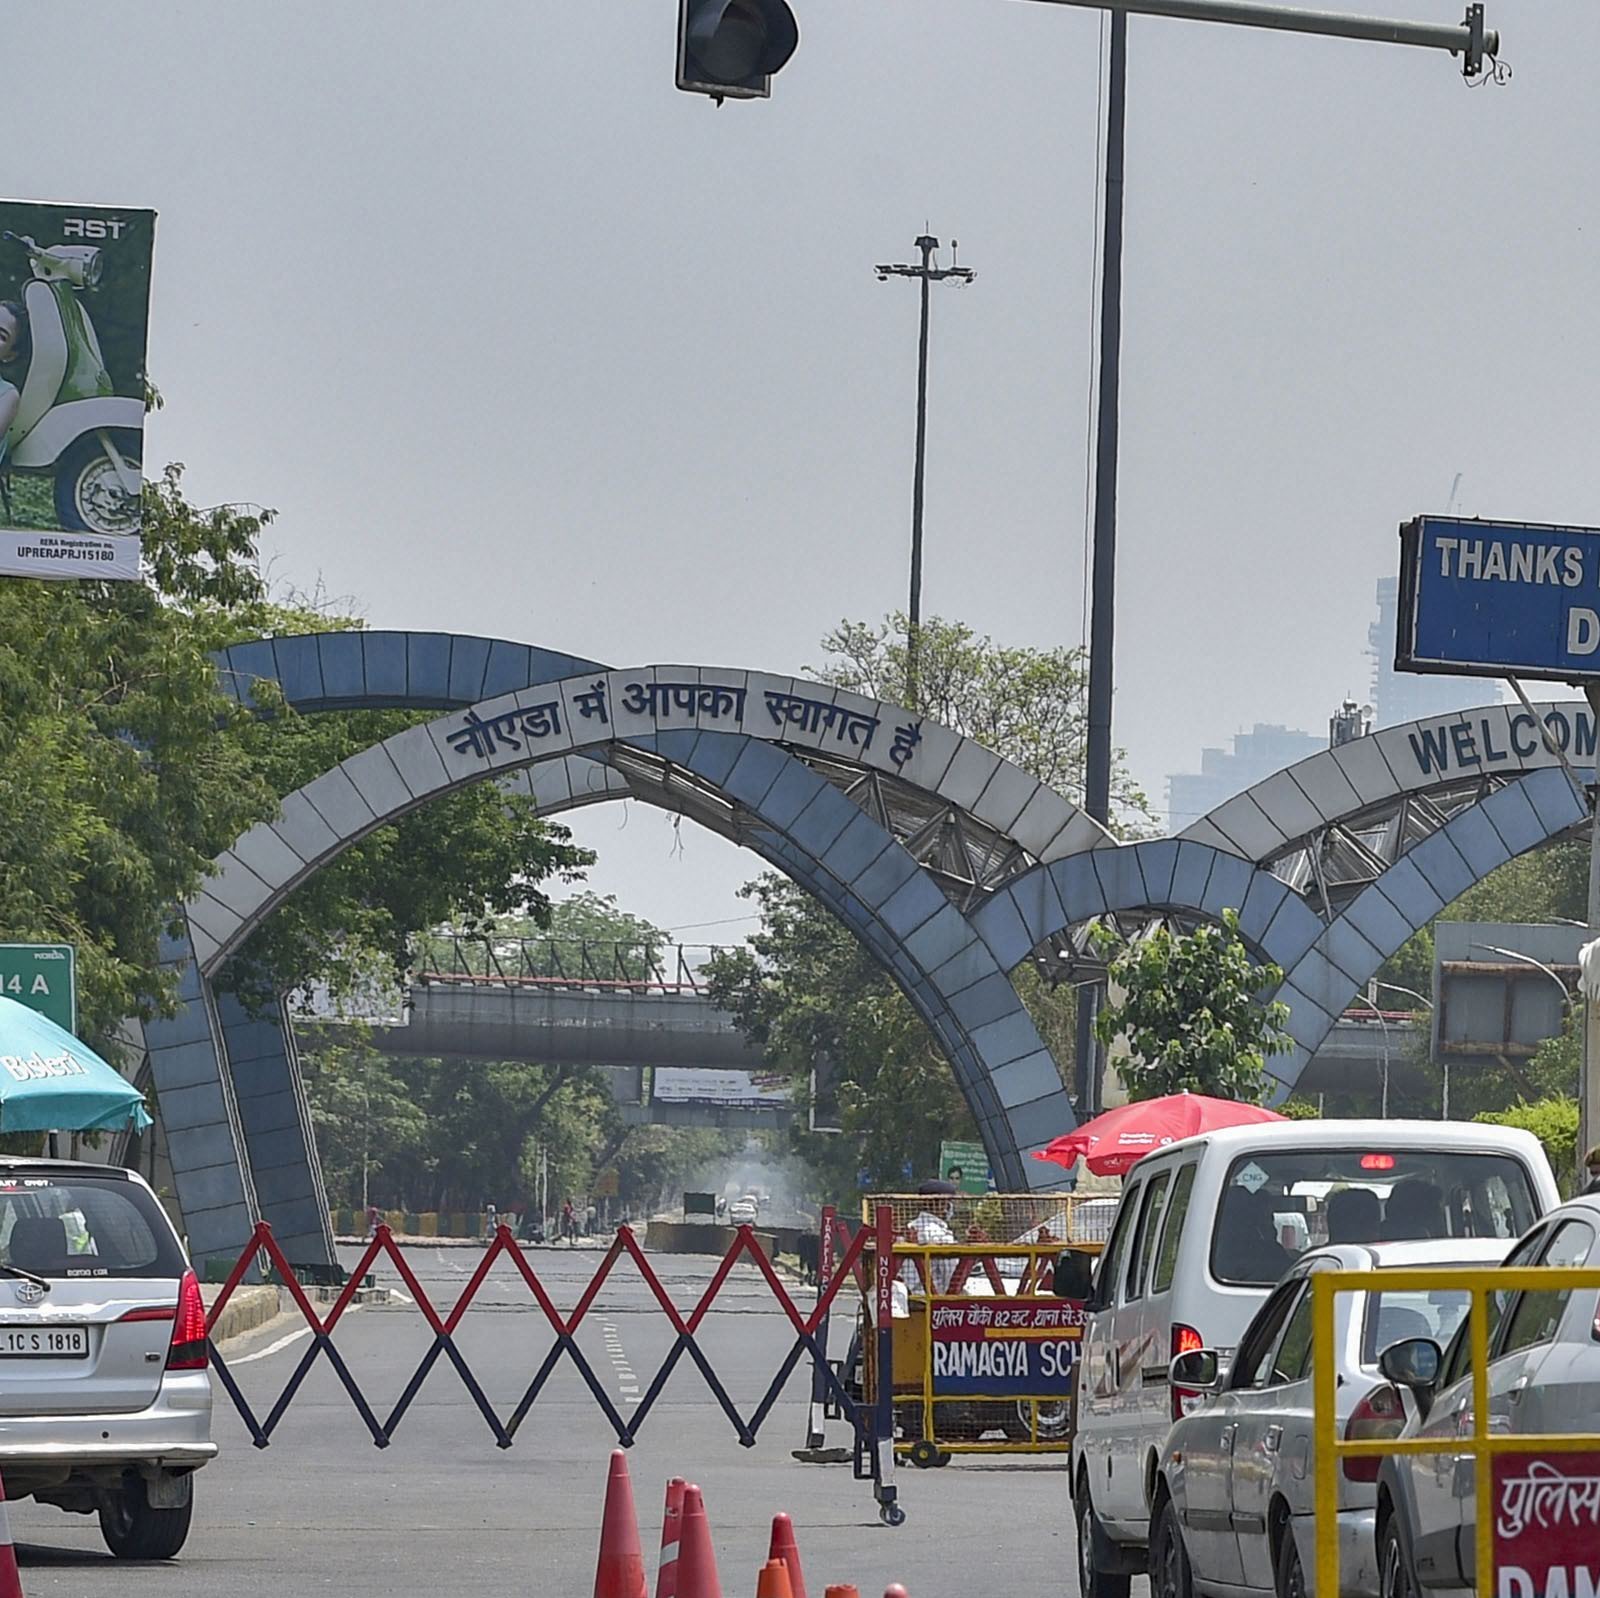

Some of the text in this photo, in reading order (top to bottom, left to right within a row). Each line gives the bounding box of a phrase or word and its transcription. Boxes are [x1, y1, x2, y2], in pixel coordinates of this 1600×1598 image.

[63, 217, 126, 240] RST
[17, 546, 114, 561] UPRERAPRJ15180
[1435, 537, 1583, 588] THANKS
[573, 679, 608, 725] में
[622, 681, 748, 723] आपका
[764, 690, 881, 749] स्वागत
[888, 721, 923, 766] है
[1408, 711, 1596, 775] WELCOM
[30, 974, 50, 995] A
[0, 1051, 86, 1082] Bisleri
[1241, 1172, 1263, 1183] CNG
[879, 1256, 889, 1310] NOIDA
[932, 1306, 963, 1330] पुलिस
[966, 1303, 994, 1327] चौकी
[994, 1310, 1010, 1328] 82
[48, 1334, 81, 1350] 1818
[933, 1341, 1029, 1377] RAMAGYA
